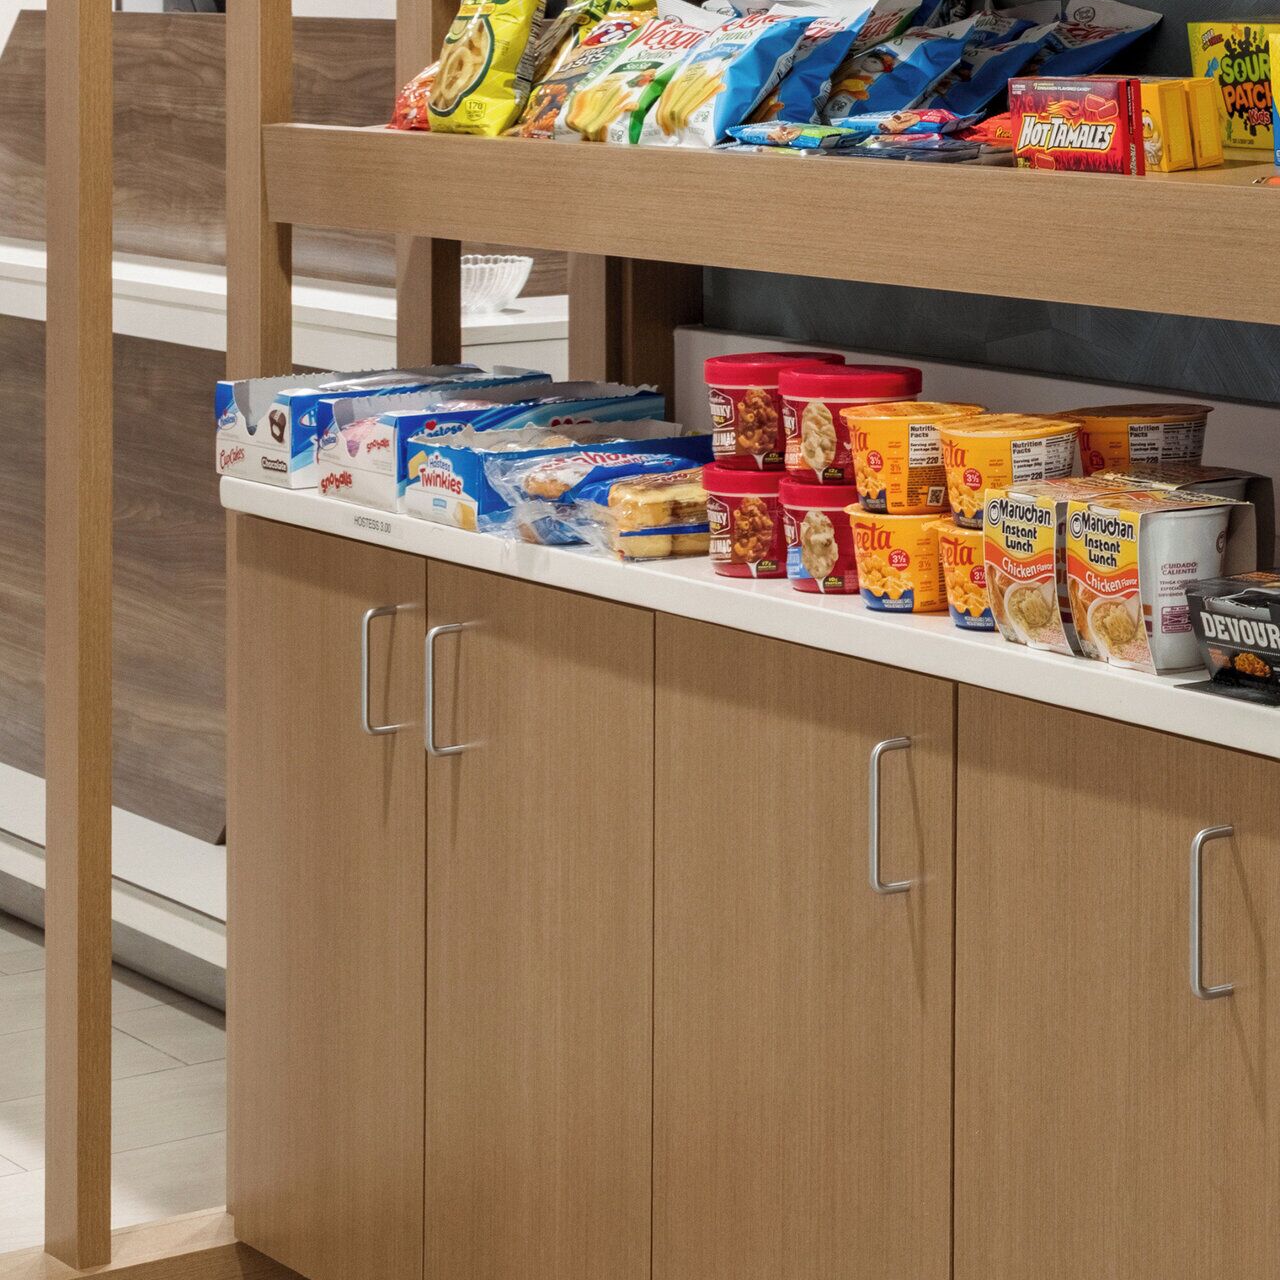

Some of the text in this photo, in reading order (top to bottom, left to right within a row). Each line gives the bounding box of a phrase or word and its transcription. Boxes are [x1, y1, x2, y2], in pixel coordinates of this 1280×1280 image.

[629, 20, 707, 52] Veggi
[1220, 51, 1271, 84] SOUR
[1247, 109, 1271, 126] Kids
[1046, 114, 1114, 152] TAMALES
[910, 431, 929, 439] Facts
[1129, 424, 1160, 432] Nutrition
[1013, 440, 1043, 449] Nutrition
[1013, 447, 1031, 455] Facts
[261, 457, 288, 472] Chocolate
[428, 458, 451, 472] Hostess
[926, 456, 938, 464] 220
[419, 467, 462, 495] Twinkies
[1030, 472, 1043, 480] 220
[999, 498, 1052, 526] Maruchan
[353, 515, 392, 533] HOSTESS 3.00
[1002, 520, 1038, 540] Instant
[1082, 511, 1135, 541] Maruchan
[1005, 534, 1034, 553] Lunch
[1085, 534, 1121, 554] Instant
[1002, 556, 1053, 578] Chicken Flavor
[1088, 549, 1118, 568] Lunch
[1085, 571, 1137, 593] Chicken Flavor
